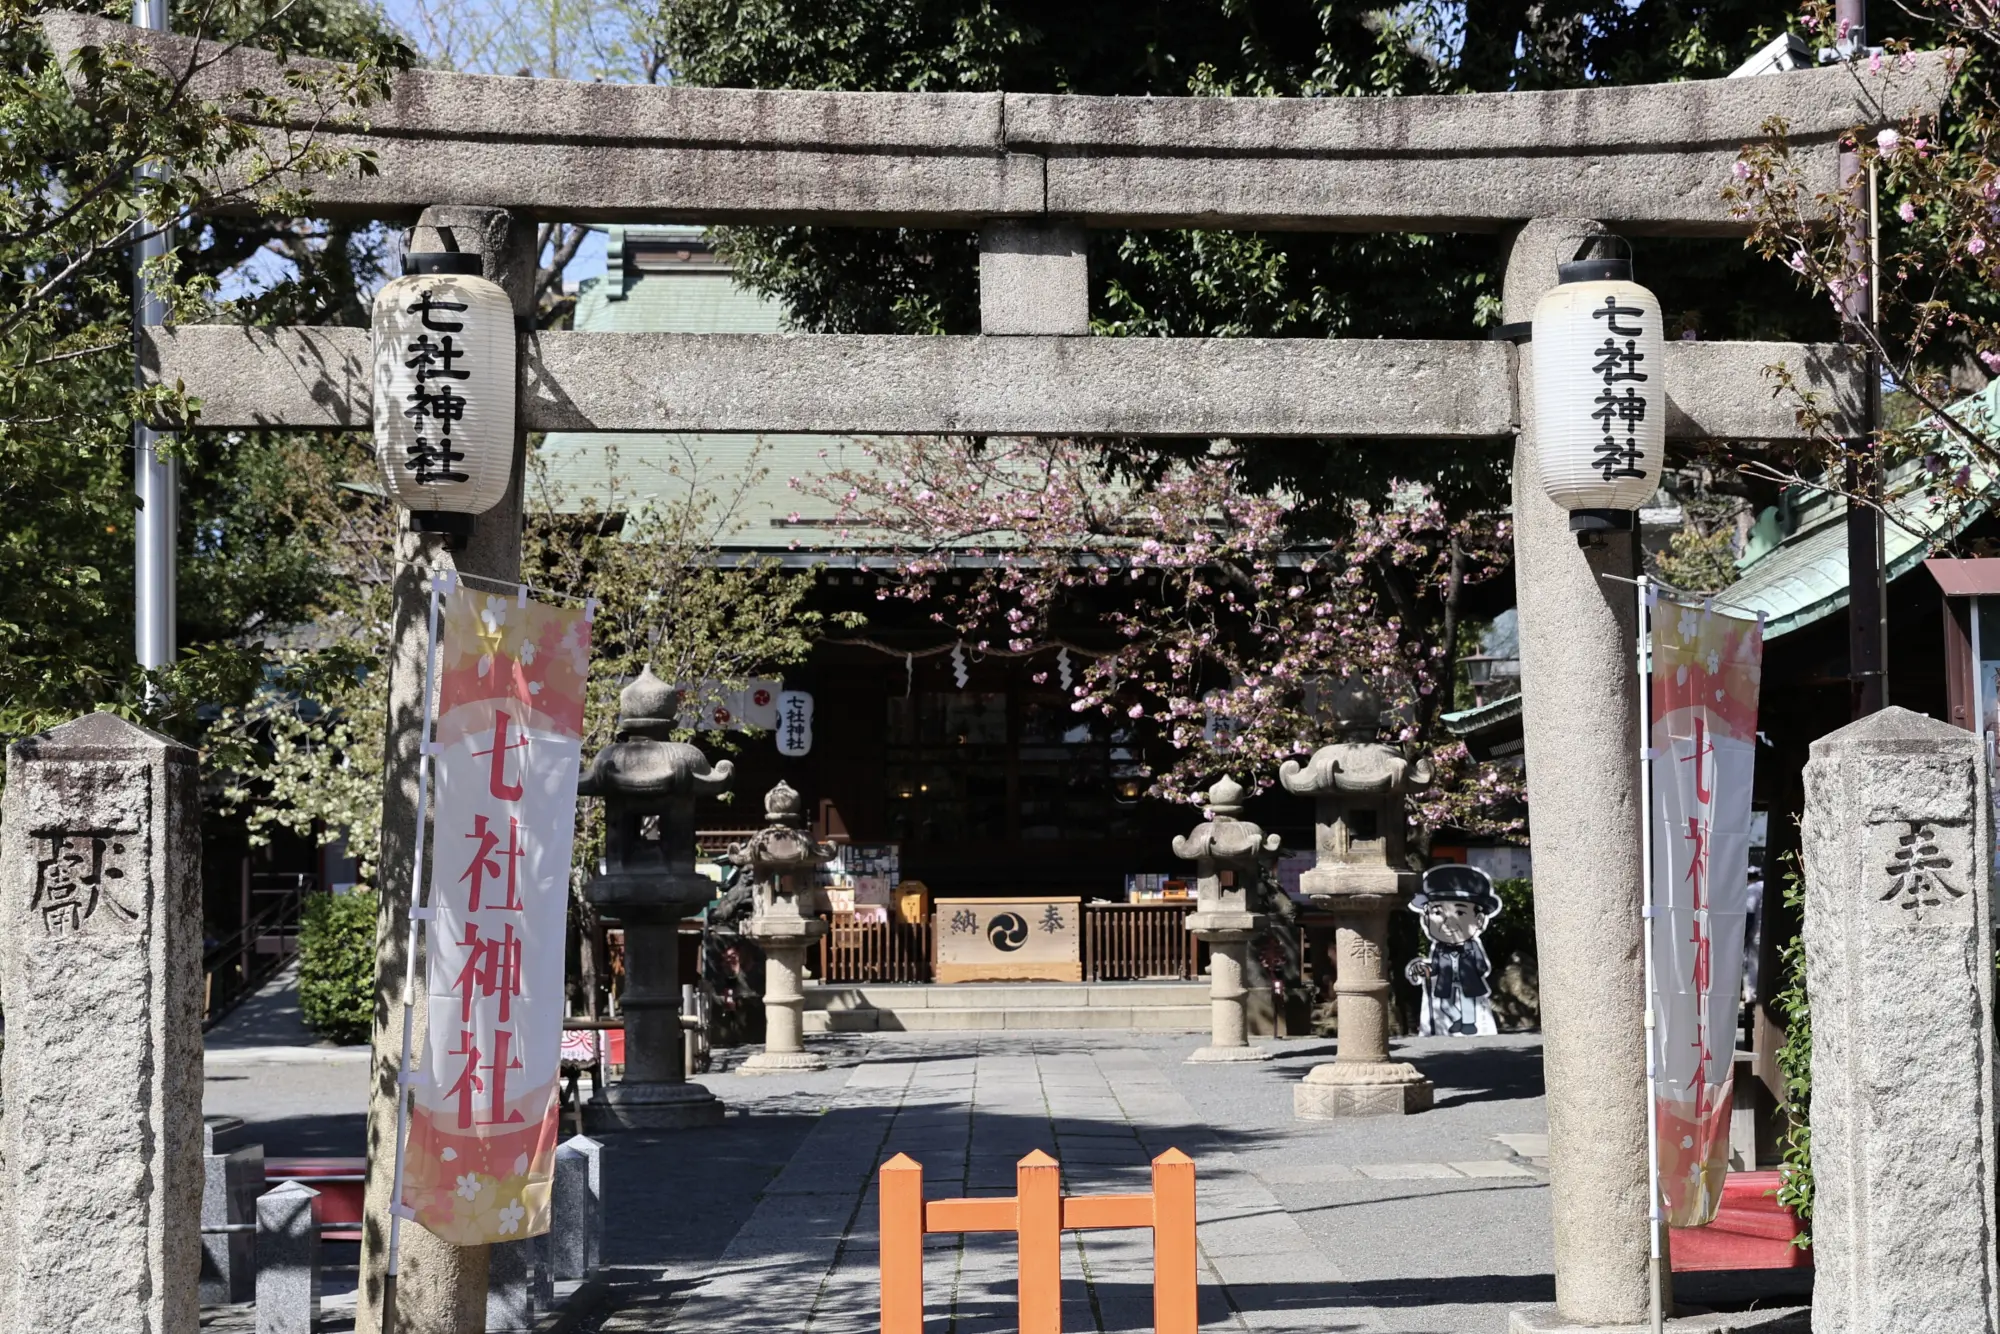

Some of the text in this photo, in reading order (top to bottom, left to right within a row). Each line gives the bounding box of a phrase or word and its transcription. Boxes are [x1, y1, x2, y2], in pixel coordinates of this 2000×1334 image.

[405, 290, 470, 485] 七社神社
[1591, 295, 1648, 481] 七社神社
[786, 696, 805, 750] 七社神社
[447, 710, 529, 1130] 七社神社
[950, 905, 1065, 935] 奉 納
[1878, 821, 1968, 921] 奉
[1351, 937, 1381, 966] 奉
